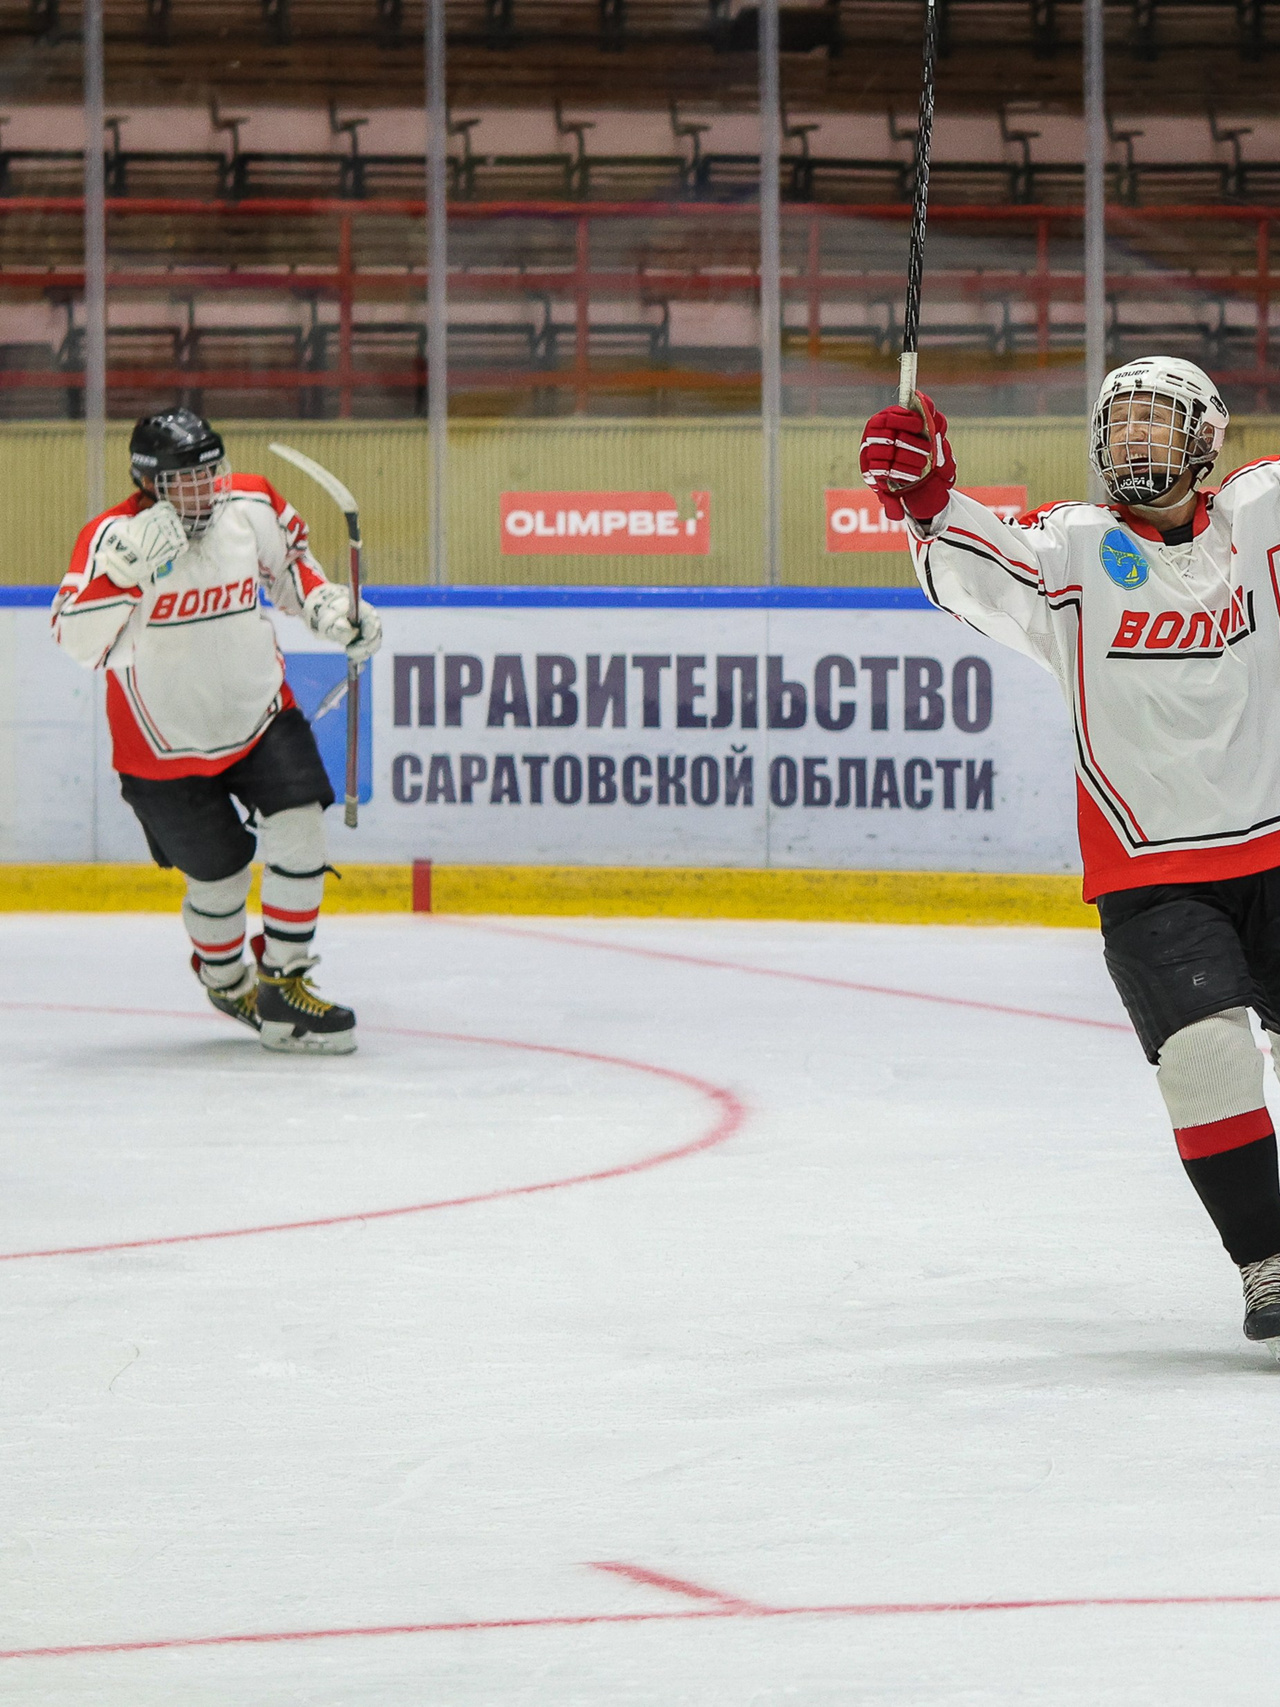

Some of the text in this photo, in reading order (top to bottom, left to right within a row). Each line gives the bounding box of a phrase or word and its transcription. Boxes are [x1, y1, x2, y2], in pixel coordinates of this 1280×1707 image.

[392, 654, 993, 732] ПРАВИТЕЛЬСТВО
[391, 744, 994, 811] САРАТОВСКОЙ ОБЛАСТИ
